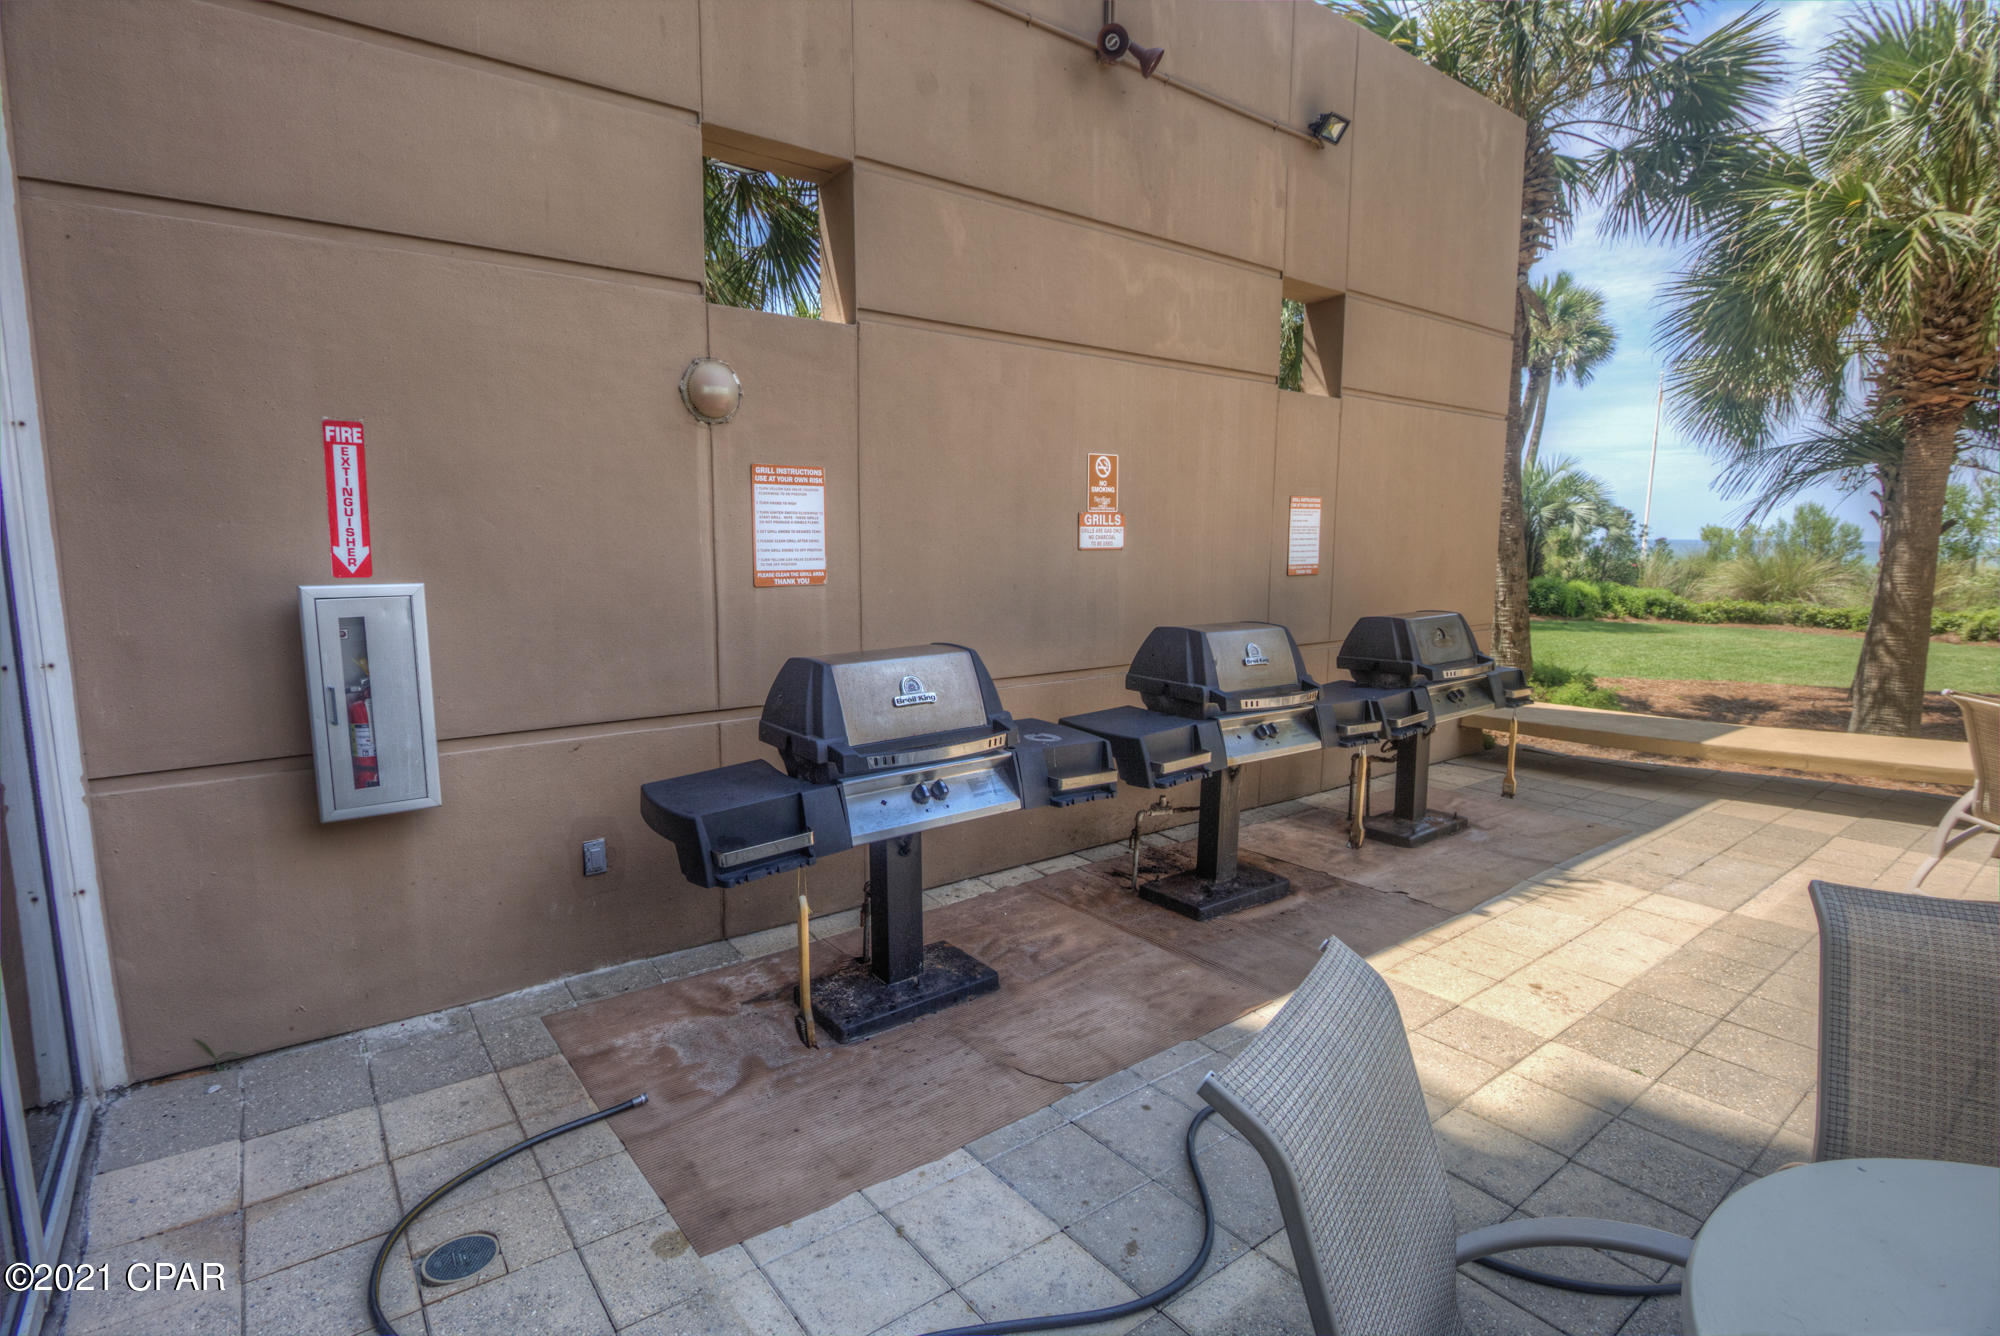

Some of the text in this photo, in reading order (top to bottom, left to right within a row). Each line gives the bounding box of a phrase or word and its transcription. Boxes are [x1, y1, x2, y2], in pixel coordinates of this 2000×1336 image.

[324, 426, 362, 444] FIRE
[776, 468, 822, 476] INSTRUCTIONS
[341, 446, 356, 567] EXTINGUISHER
[1084, 514, 1121, 525] GRILLS
